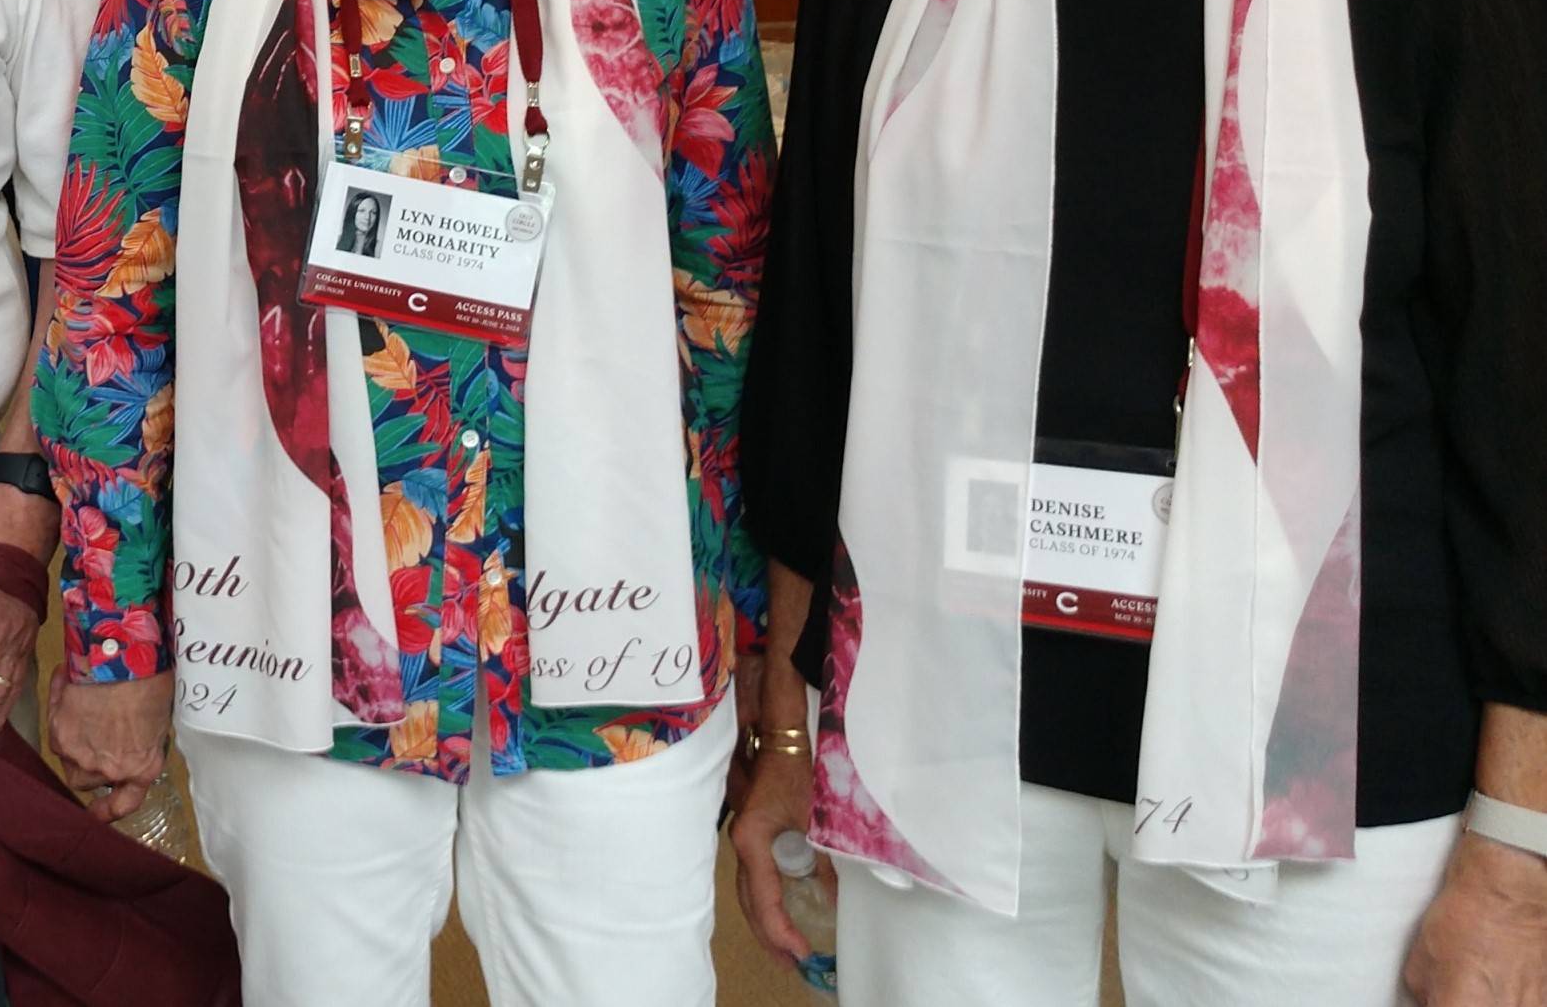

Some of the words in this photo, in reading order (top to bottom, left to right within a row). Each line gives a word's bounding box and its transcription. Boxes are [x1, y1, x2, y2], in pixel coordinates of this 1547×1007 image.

[400, 208, 435, 227] LYN
[439, 217, 514, 243] HOWELL
[396, 227, 501, 259] MORIARITY
[393, 243, 434, 261] CLASS
[436, 251, 454, 264] OF
[457, 255, 484, 271] 1974
[316, 273, 352, 286] COLGATE
[353, 280, 402, 297] UNIVERSITY
[407, 292, 428, 312] C
[455, 301, 495, 317] ACCESS
[497, 309, 523, 322] PASS
[1030, 498, 1105, 520] DENISE
[1030, 519, 1143, 546] CASHMERE
[1029, 538, 1075, 553] CLASS
[1079, 544, 1097, 557] OF
[1103, 547, 1136, 561] 1974
[526, 570, 661, 631] lgate
[1056, 591, 1079, 614] C
[584, 637, 642, 692] of
[650, 644, 693, 687] 19
[1135, 796, 1192, 834] 74
